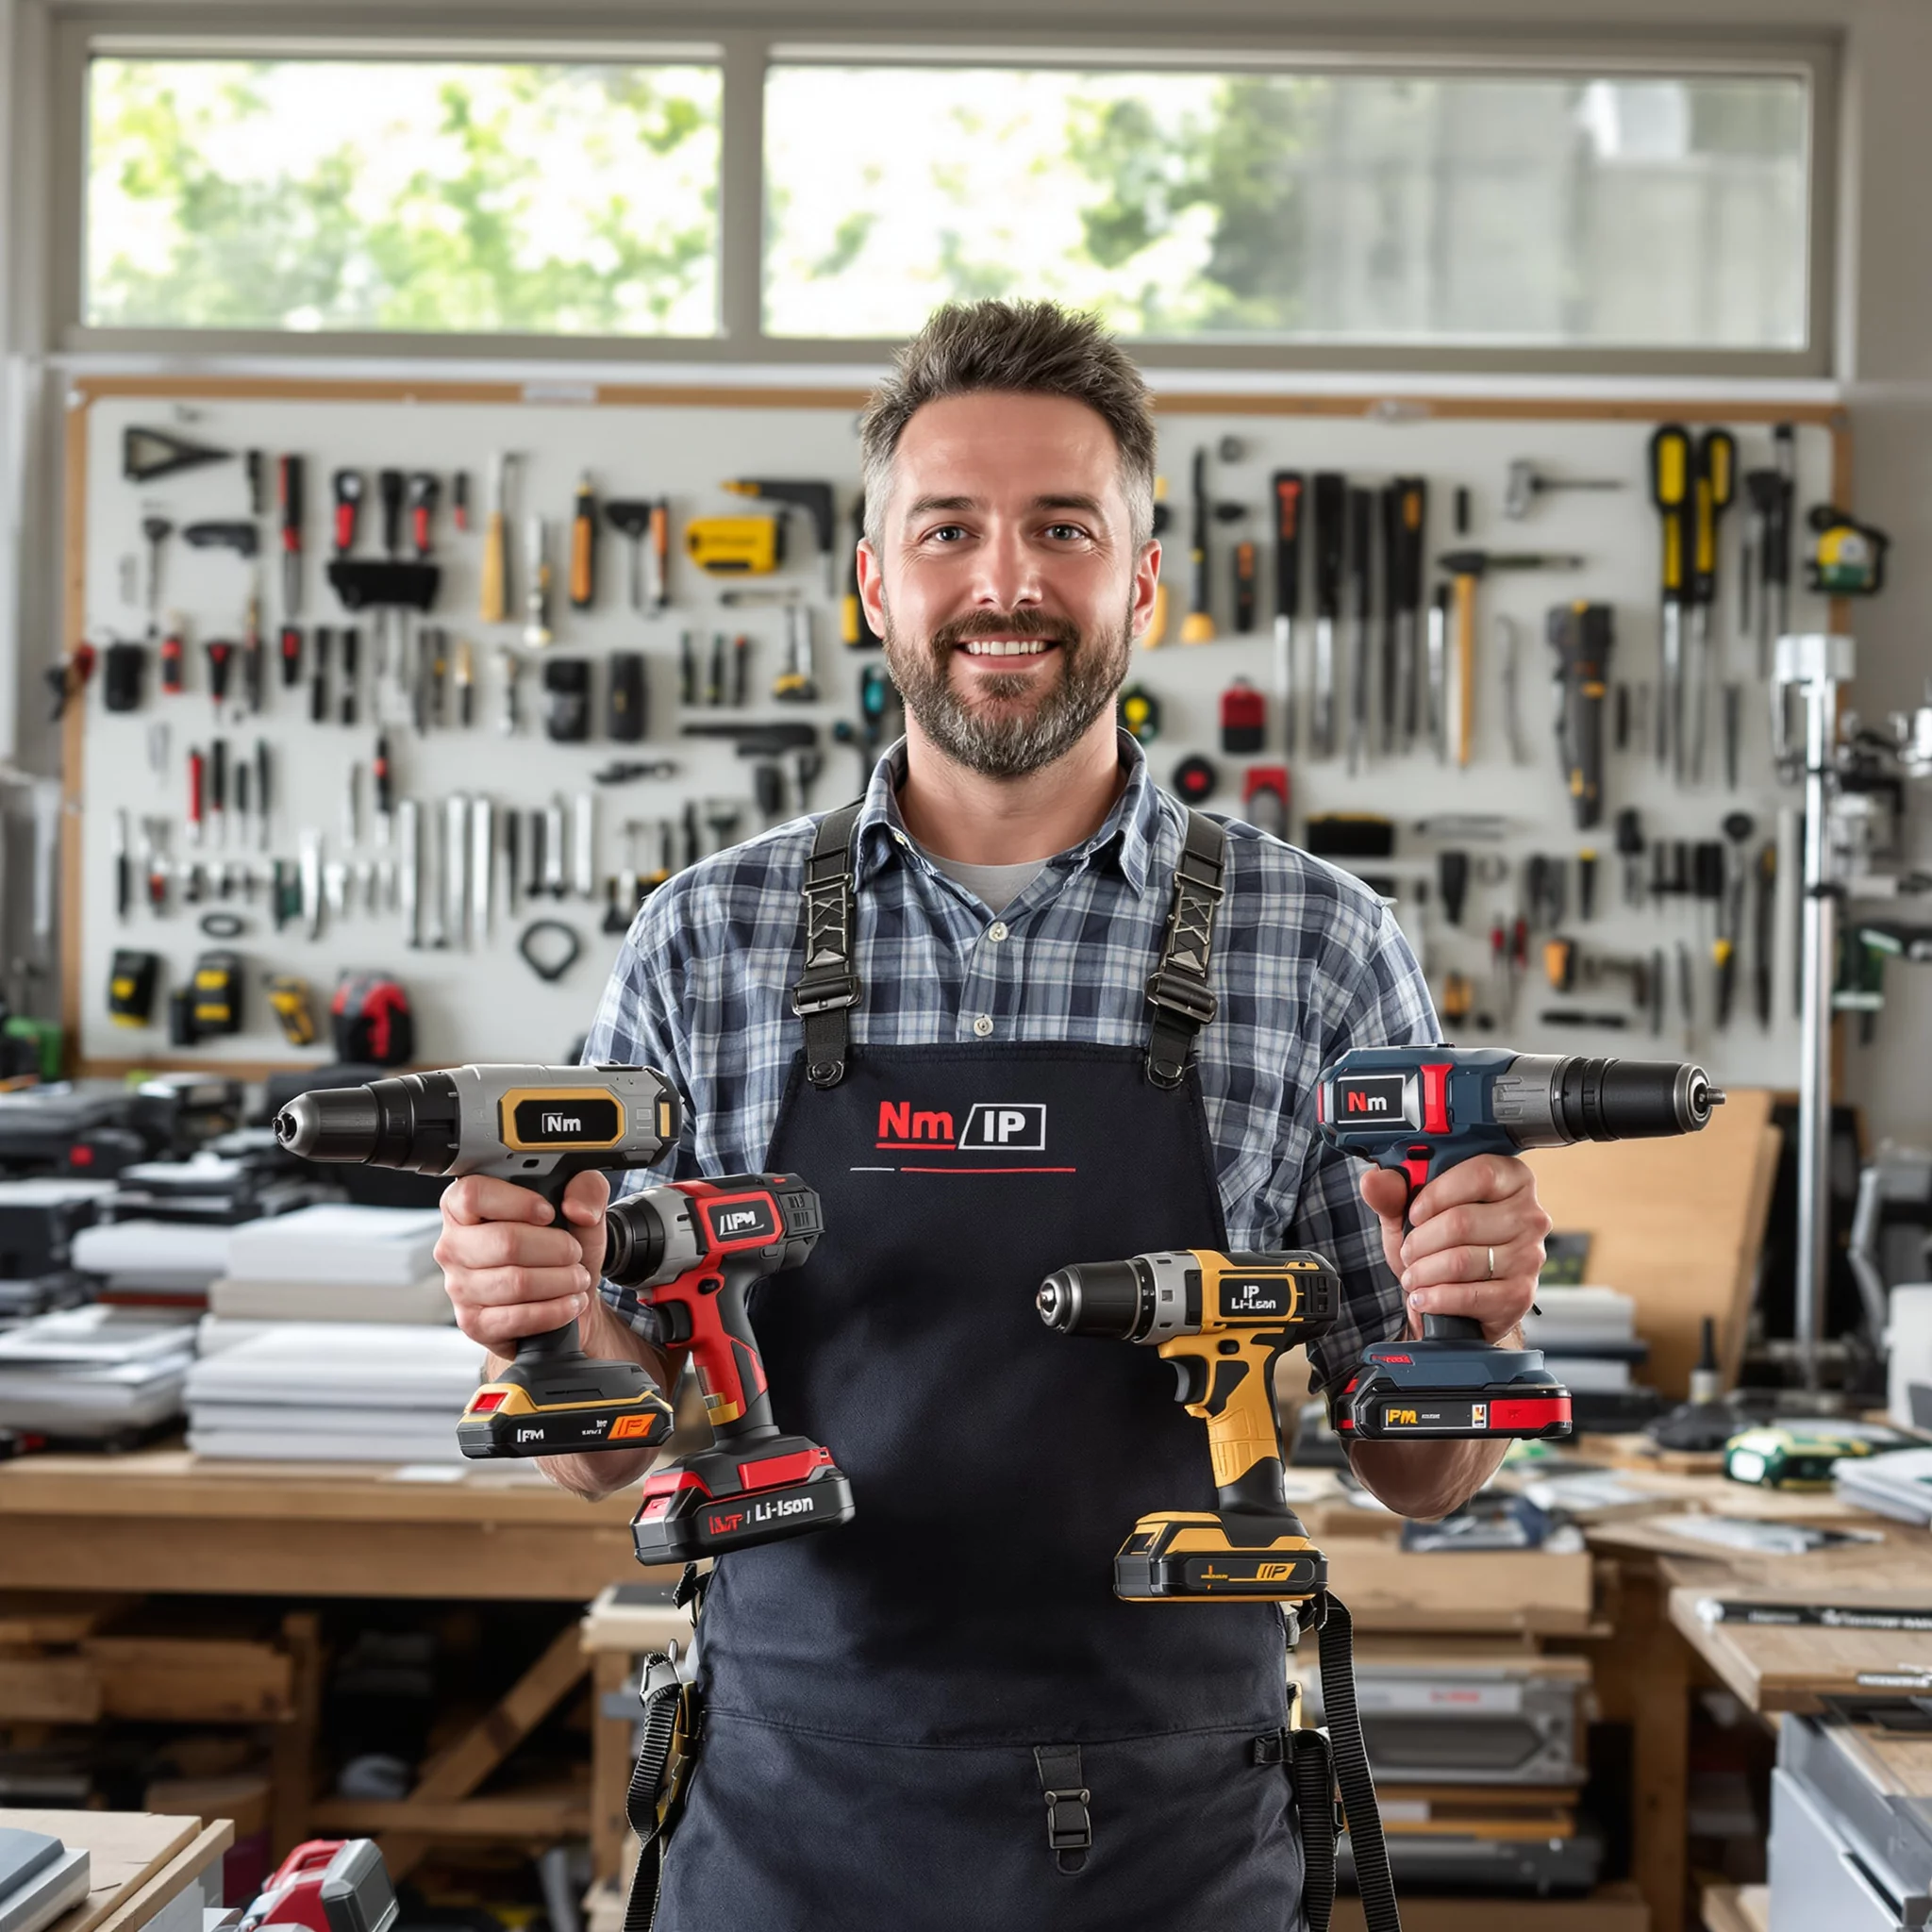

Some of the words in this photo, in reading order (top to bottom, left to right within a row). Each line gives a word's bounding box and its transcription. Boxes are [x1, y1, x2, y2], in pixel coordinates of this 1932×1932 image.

[1348, 1091, 1388, 1112] Nm
[547, 1116, 581, 1132] Nm
[878, 1101, 955, 1141] Nm
[983, 1110, 1026, 1142] IP
[1242, 1285, 1260, 1299] IP
